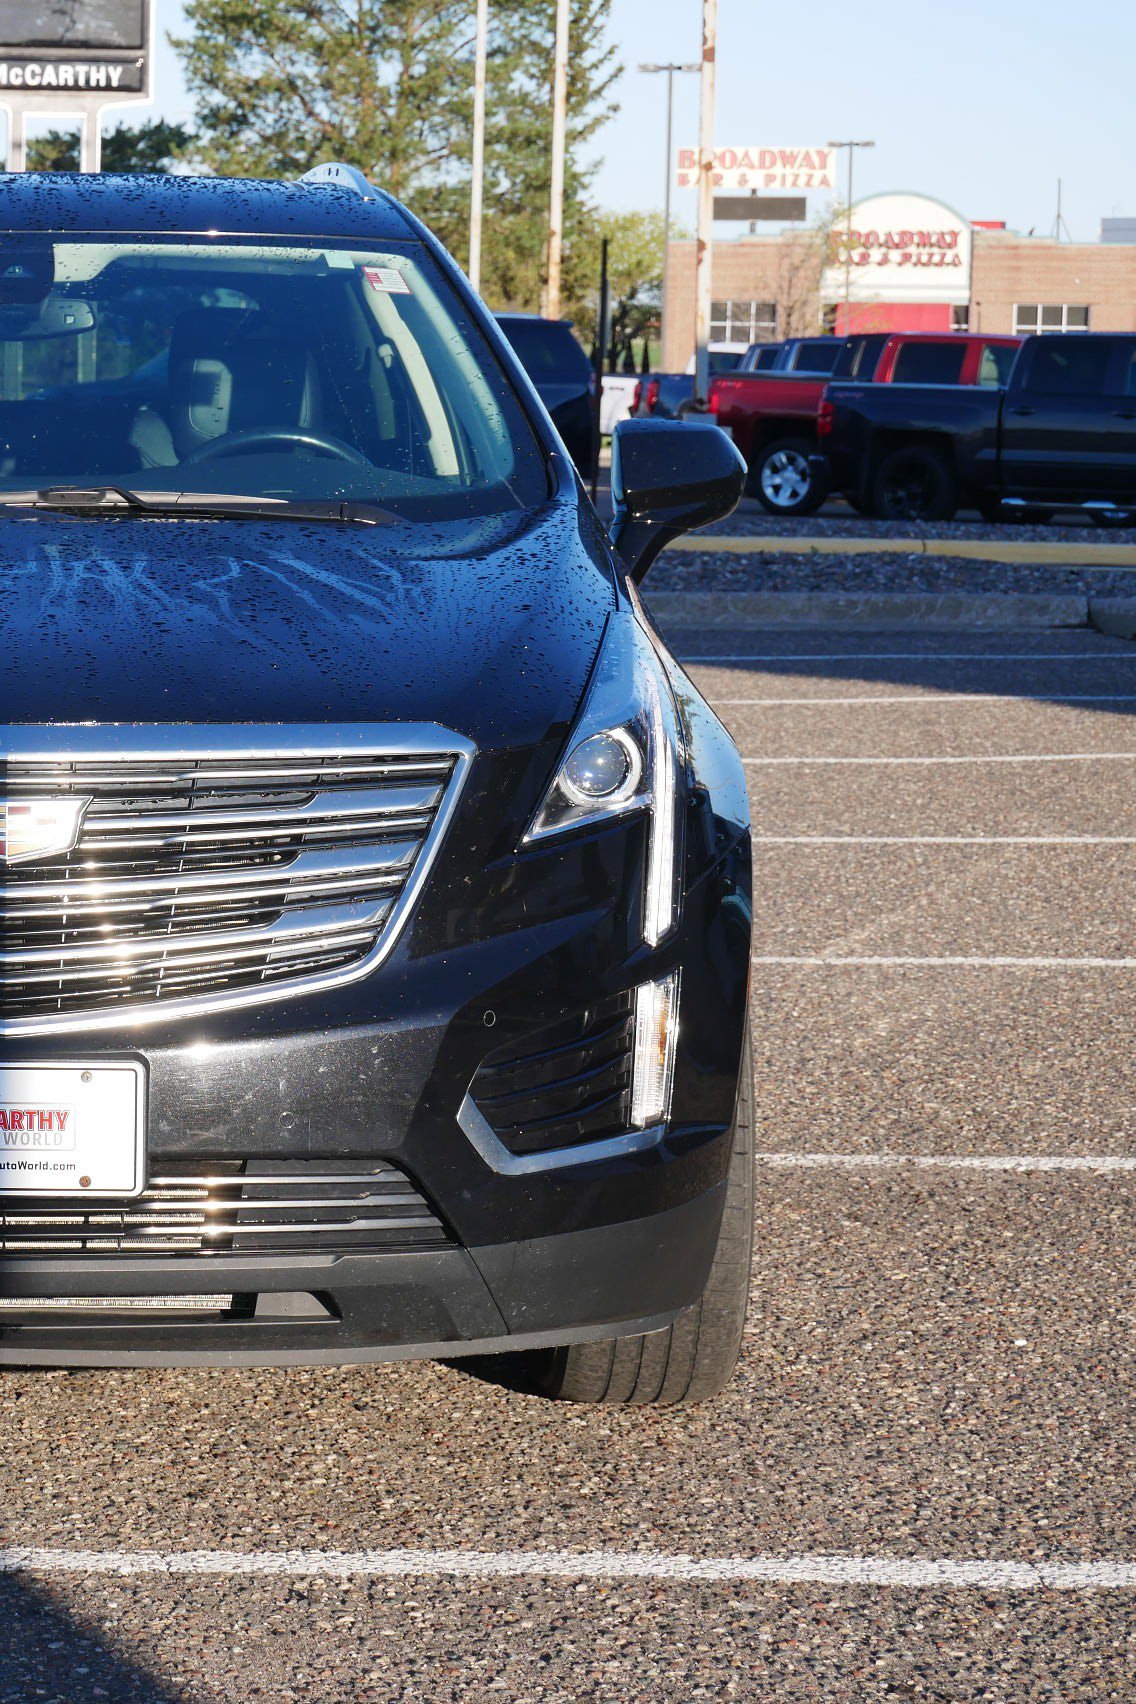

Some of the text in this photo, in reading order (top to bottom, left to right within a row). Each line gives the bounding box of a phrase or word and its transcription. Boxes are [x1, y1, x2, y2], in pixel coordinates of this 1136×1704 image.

[677, 149, 832, 170] BOADWAY
[763, 173, 832, 187] PIZZA
[897, 252, 962, 267] PIZZA
[2, 1132, 63, 1146] WORLD
